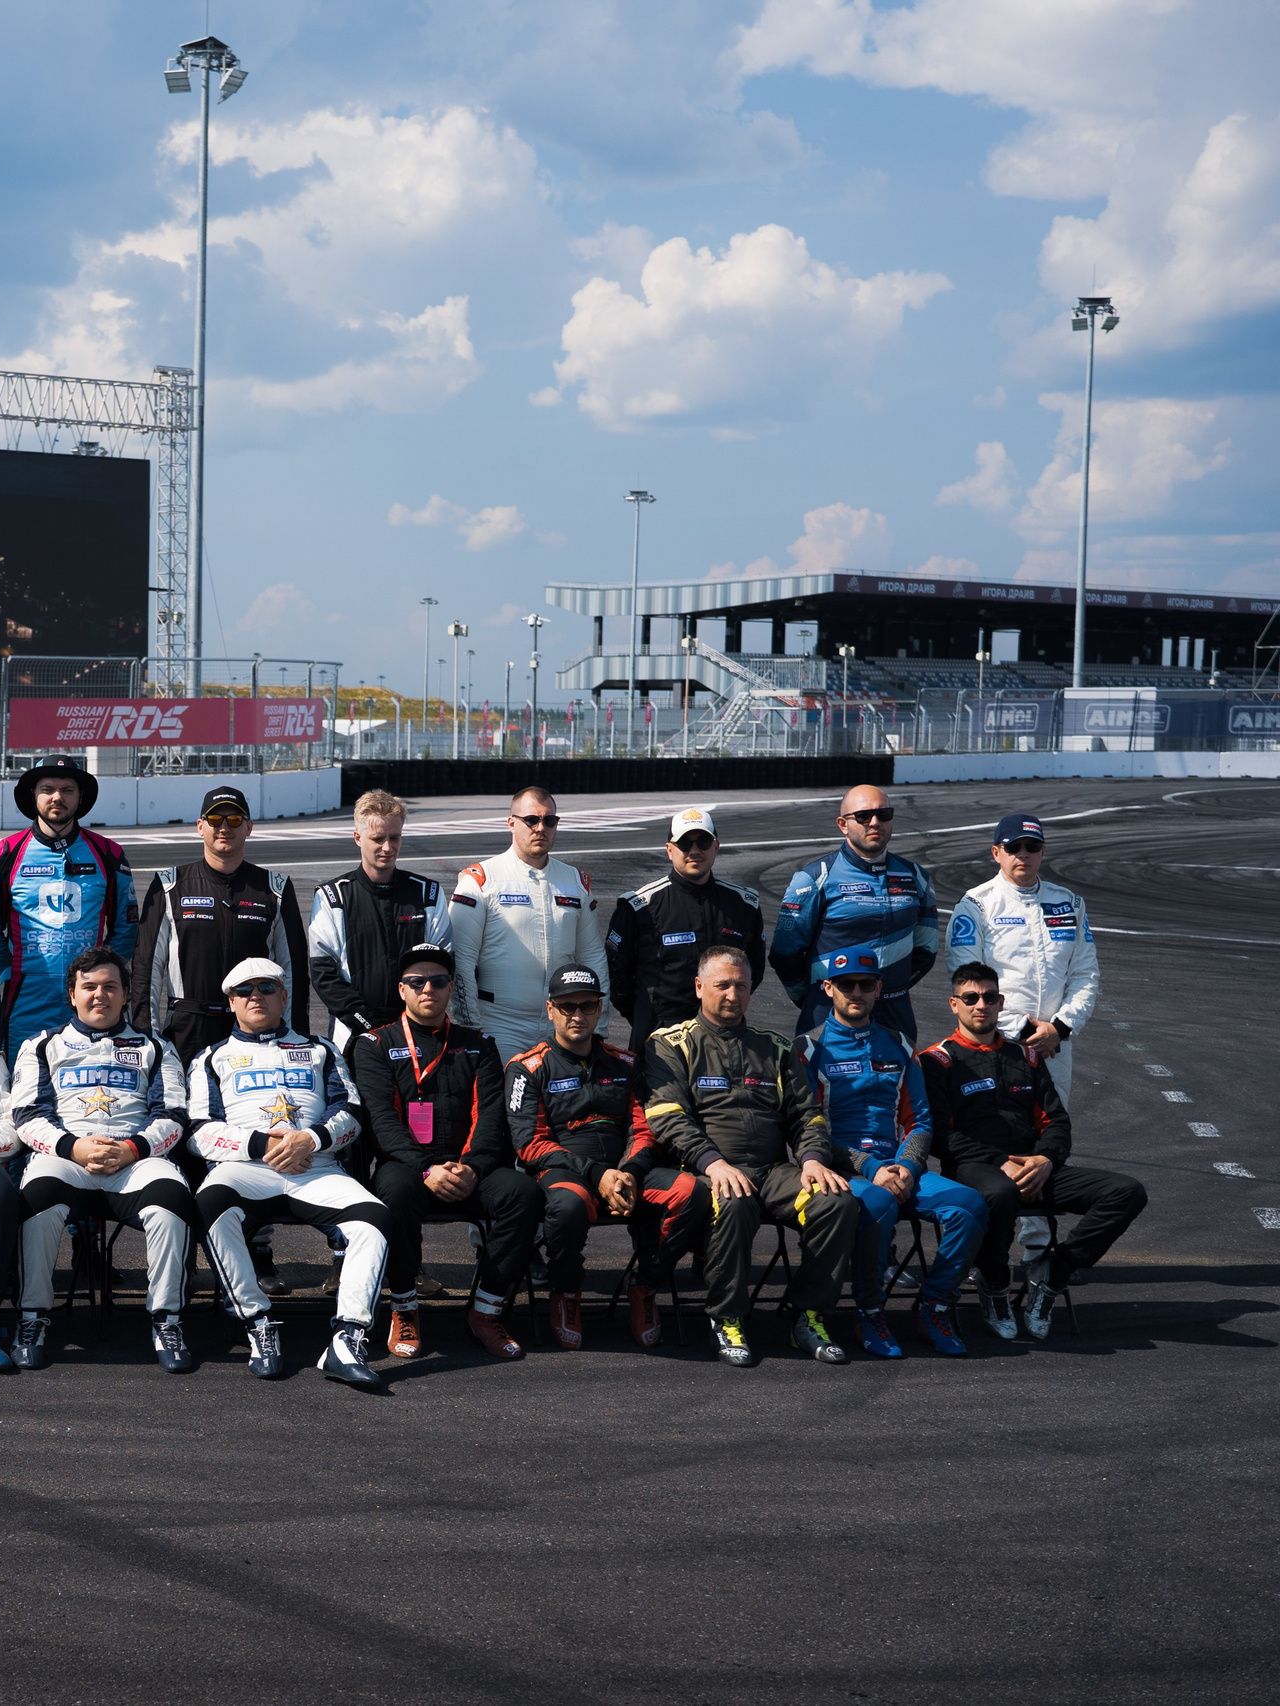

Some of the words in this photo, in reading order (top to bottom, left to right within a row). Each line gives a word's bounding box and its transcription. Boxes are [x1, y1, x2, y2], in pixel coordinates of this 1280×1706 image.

[878, 581, 905, 593] ИГОРА
[981, 586, 1006, 598] ИГОРА
[57, 706, 106, 717] RUSSIAN
[67, 718, 101, 728] DRIFT
[105, 705, 190, 739] RDS
[284, 705, 316, 736] RDS
[986, 709, 1035, 727] AIMOL
[1087, 709, 1166, 727] AIMOL
[1232, 711, 1280, 728] AIM
[57, 729, 96, 740] SERIES
[23, 866, 53, 874] AIMOL
[840, 884, 869, 893] AIMOL
[46, 893, 75, 913] VK
[183, 898, 213, 906] AIMOL
[499, 894, 529, 903] AIMOL
[1052, 904, 1072, 915] ВТБ
[995, 918, 1025, 926] AIMOL
[664, 934, 694, 944] AIMOL
[829, 1063, 860, 1074] AIMOL
[61, 1068, 138, 1086] AIMOL
[237, 1069, 312, 1091] AIMOL
[699, 1078, 729, 1088] AIMOL
[550, 1079, 579, 1092] AIMOL
[964, 1080, 995, 1094] AIMOL
[557, 1328, 579, 1343] OMP
[395, 1343, 417, 1356] OMP
